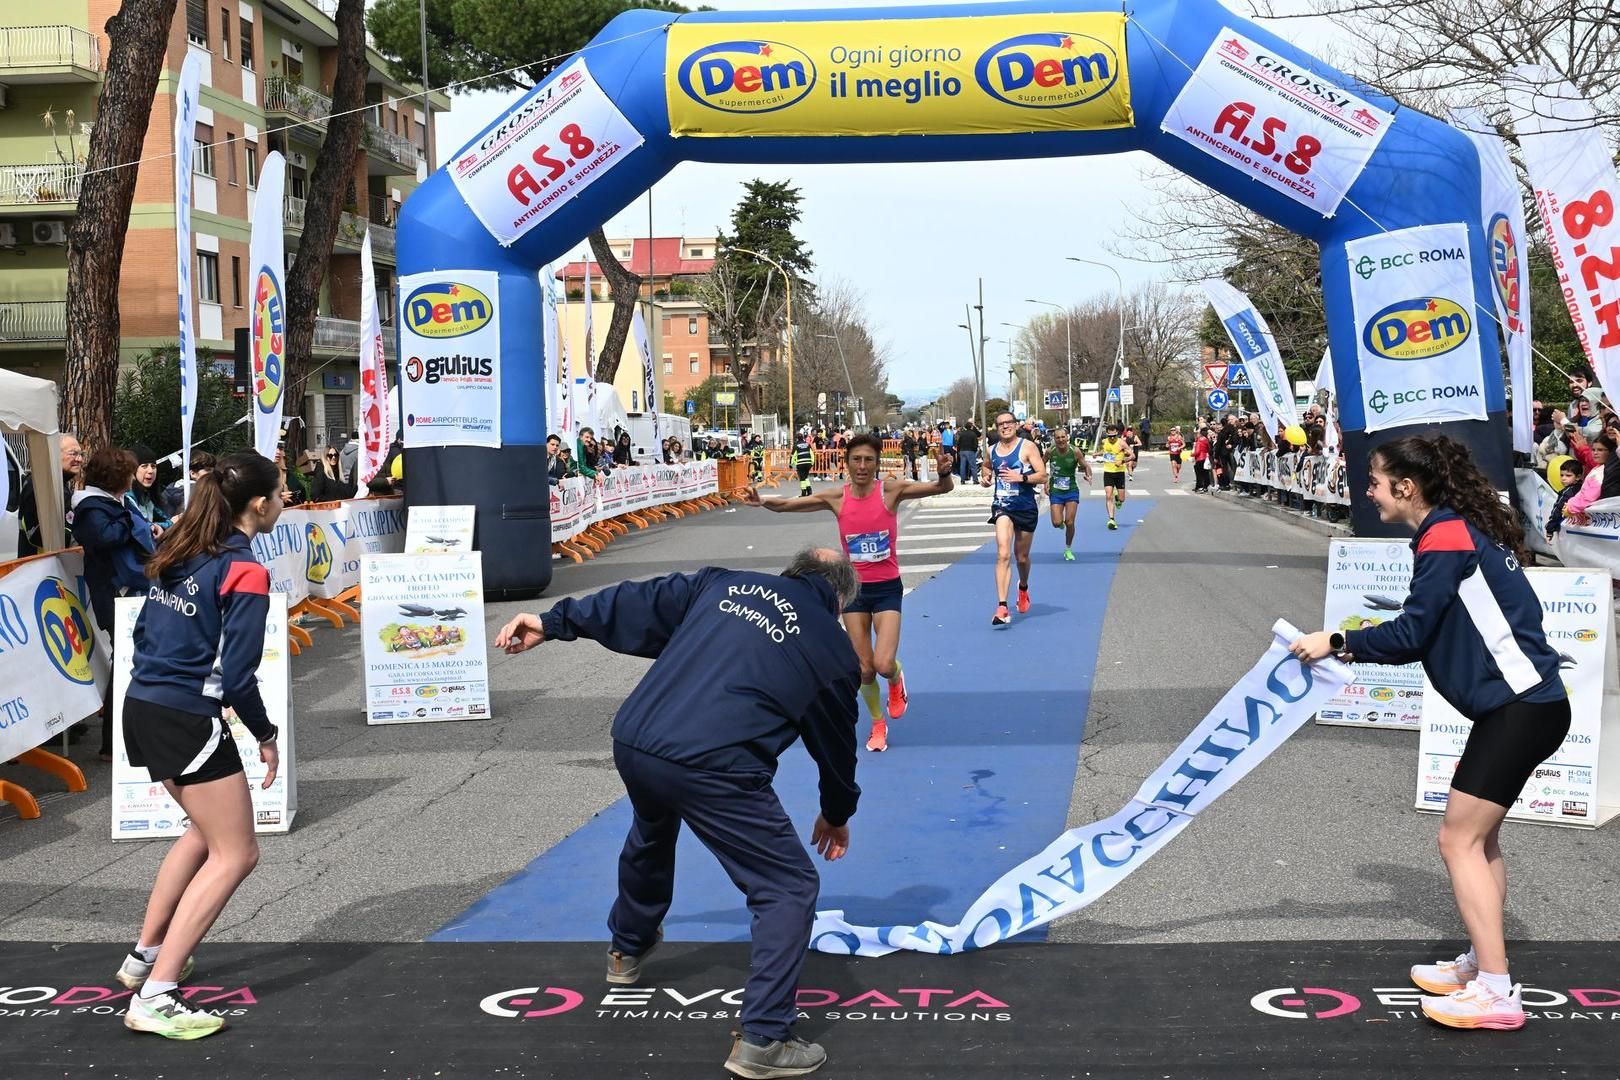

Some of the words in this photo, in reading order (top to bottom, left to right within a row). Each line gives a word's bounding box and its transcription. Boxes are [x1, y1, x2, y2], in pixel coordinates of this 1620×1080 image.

[829, 45, 883, 69] Ogni
[888, 46, 963, 70] giorno
[699, 57, 808, 97] Dem
[829, 72, 848, 98] il
[855, 70, 964, 104] meglio
[1000, 51, 1110, 96] Dem
[1255, 54, 1352, 108] GROSSI
[718, 93, 786, 109] supermercati
[1017, 87, 1089, 105] supermercati
[1219, 59, 1275, 94] COMPRAVENDITE
[1277, 89, 1321, 118] VALUTAZIONI
[1320, 112, 1364, 139] IMMOBILIARI
[480, 86, 555, 152] GROSSI
[468, 144, 513, 180] COMPRAVENDITE
[514, 114, 550, 144] VALUTAZIONI
[548, 87, 584, 116] IMMOBILIARI
[1213, 101, 1323, 176] A.S.8
[507, 123, 596, 207] A.S.8
[1185, 125, 1252, 166] ANTINCENDIO
[1252, 161, 1262, 170] E
[1261, 165, 1316, 200] SICUREZZA
[513, 185, 569, 230] ANTINCENDIO
[567, 176, 576, 187] E
[574, 143, 622, 182] SICUREZZA
[1299, 176, 1318, 190] S.R.L.
[1381, 253, 1414, 270] BCC
[1419, 247, 1466, 264] ROMA
[411, 298, 487, 328] Dem
[265, 296, 284, 387] Dem
[422, 324, 470, 335] supermercati
[1377, 312, 1466, 351] Dem
[1394, 340, 1451, 357] supermercati
[425, 354, 494, 385] giulius
[1393, 389, 1427, 405] BCC
[1432, 385, 1480, 400] ROMA
[861, 542, 878, 553] 80
[385, 574, 417, 584] VOLA
[418, 572, 476, 582] CIAMPINO
[1354, 562, 1387, 572] VOLA
[1375, 574, 1411, 582] TROFEO
[149, 585, 197, 617] CIAMPINO
[728, 584, 800, 635] RUNNERS
[1543, 600, 1597, 615] MPINO
[719, 599, 784, 643] CIAMPINO
[370, 662, 420, 672] DOMENICA
[421, 661, 430, 670] 15
[431, 660, 464, 669] MARZO
[391, 687, 411, 695] A.S.8
[1430, 723, 1472, 735] DOMEN
[1535, 769, 1561, 778] giulius
[595, 1010, 812, 1020] TIMING&A
[825, 1011, 1011, 1022] SOLUTIONS
